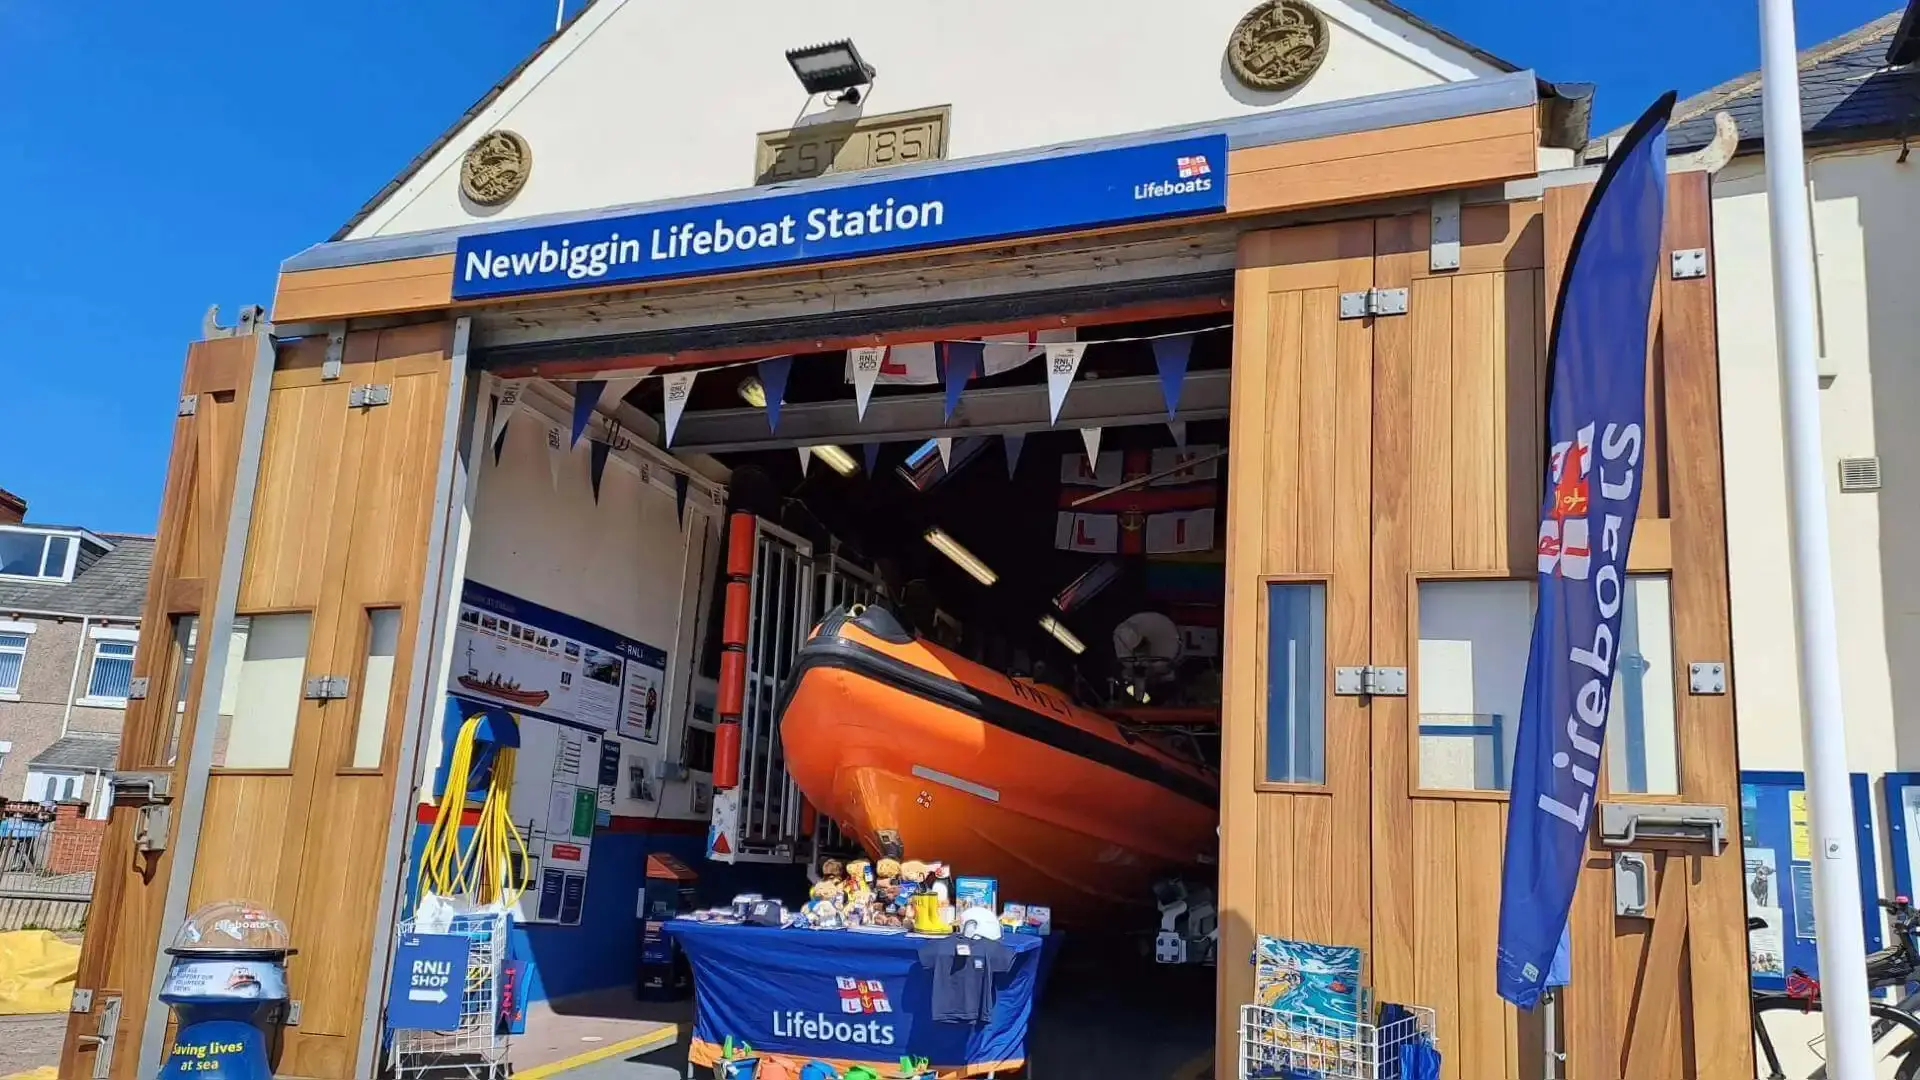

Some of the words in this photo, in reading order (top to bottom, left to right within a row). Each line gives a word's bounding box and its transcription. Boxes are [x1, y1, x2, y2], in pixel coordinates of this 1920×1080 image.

[773, 138, 845, 178] EST
[866, 124, 933, 168] 1851
[1134, 176, 1212, 200] Lifeboats
[464, 233, 639, 282] Newbiggin
[651, 214, 795, 260] Lifeboat
[806, 197, 944, 242] Station
[1538, 422, 1642, 834] Lifeboats
[627, 645, 644, 659] RNLI
[412, 960, 451, 976] RNLI
[411, 975, 449, 987] SHOP
[772, 1010, 895, 1045] Lifeboats
[209, 1041, 243, 1051] lives
[180, 1060, 192, 1071] at
[195, 1060, 219, 1070] sea
